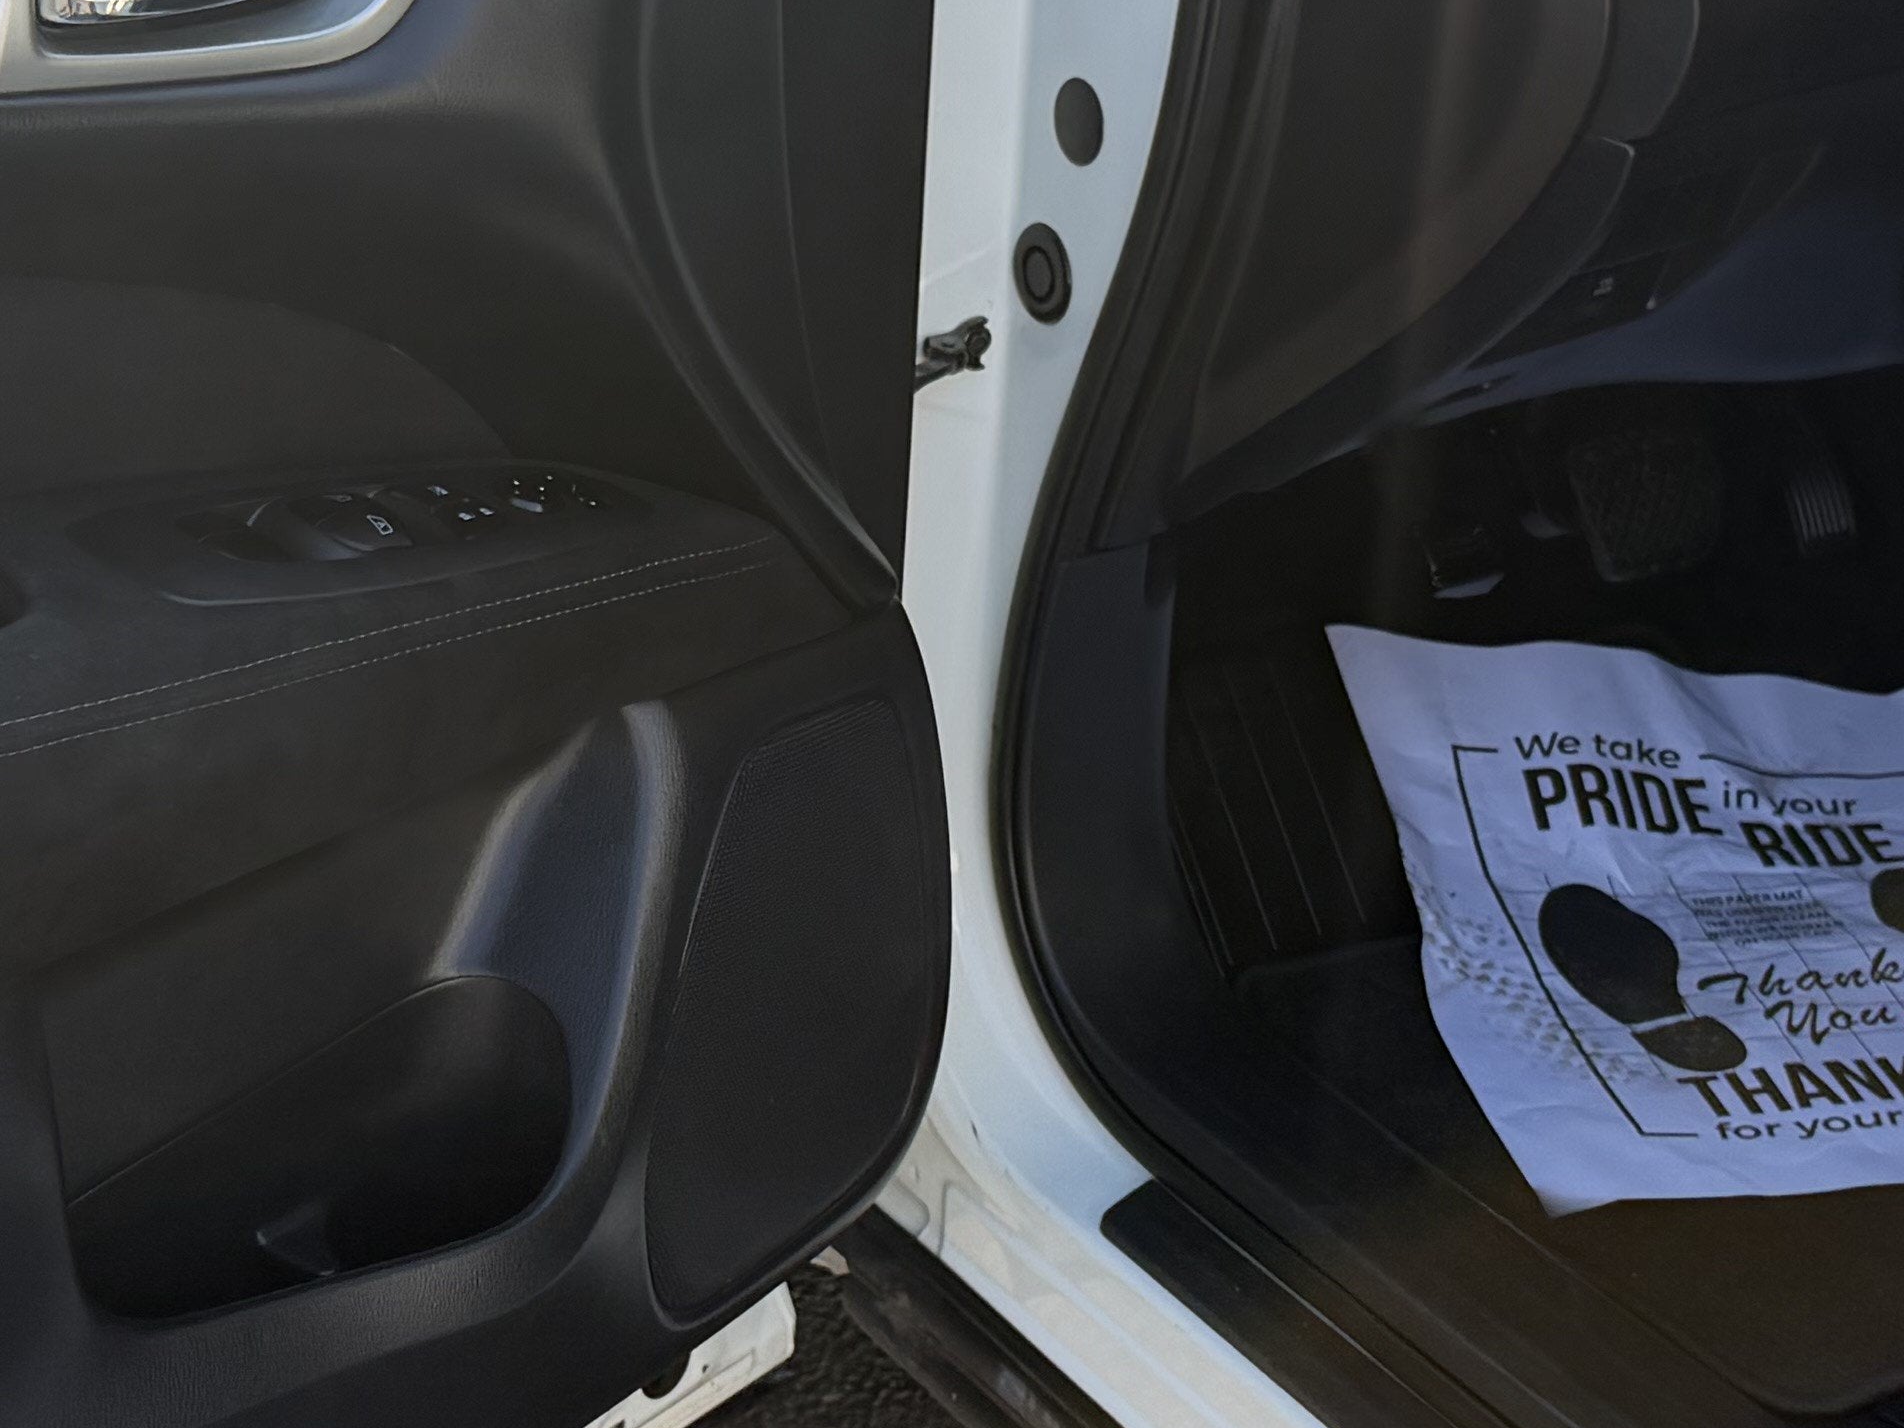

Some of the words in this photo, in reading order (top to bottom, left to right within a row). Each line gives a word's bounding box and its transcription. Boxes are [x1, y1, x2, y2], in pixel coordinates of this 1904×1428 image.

[1514, 731, 1581, 760] We
[1595, 733, 1681, 769] take
[1521, 763, 1724, 837] PRIDE
[1722, 780, 1760, 811] in
[1770, 794, 1858, 818] your
[1715, 1119, 1782, 1141] for
[1794, 1108, 1903, 1140] your
